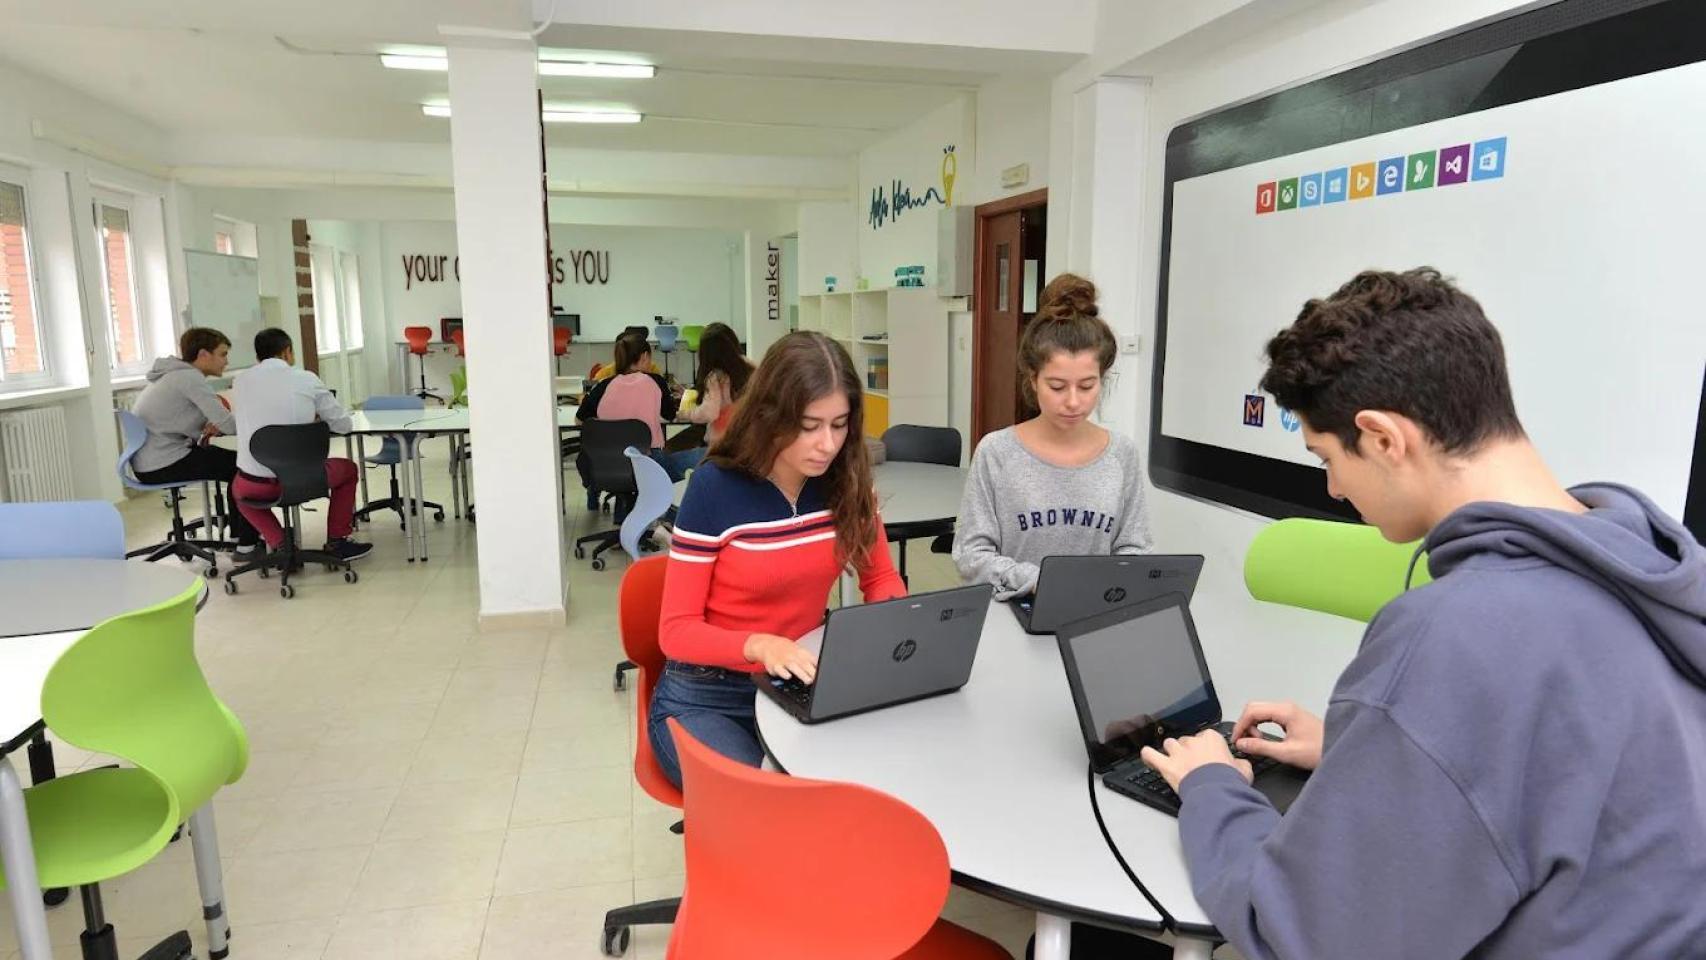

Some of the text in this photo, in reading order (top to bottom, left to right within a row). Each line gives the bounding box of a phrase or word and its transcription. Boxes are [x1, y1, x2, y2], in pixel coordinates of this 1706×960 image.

[402, 254, 447, 290] your
[570, 249, 609, 285] YOU
[765, 241, 780, 321] maker
[1018, 508, 1114, 533] BROWNIE
